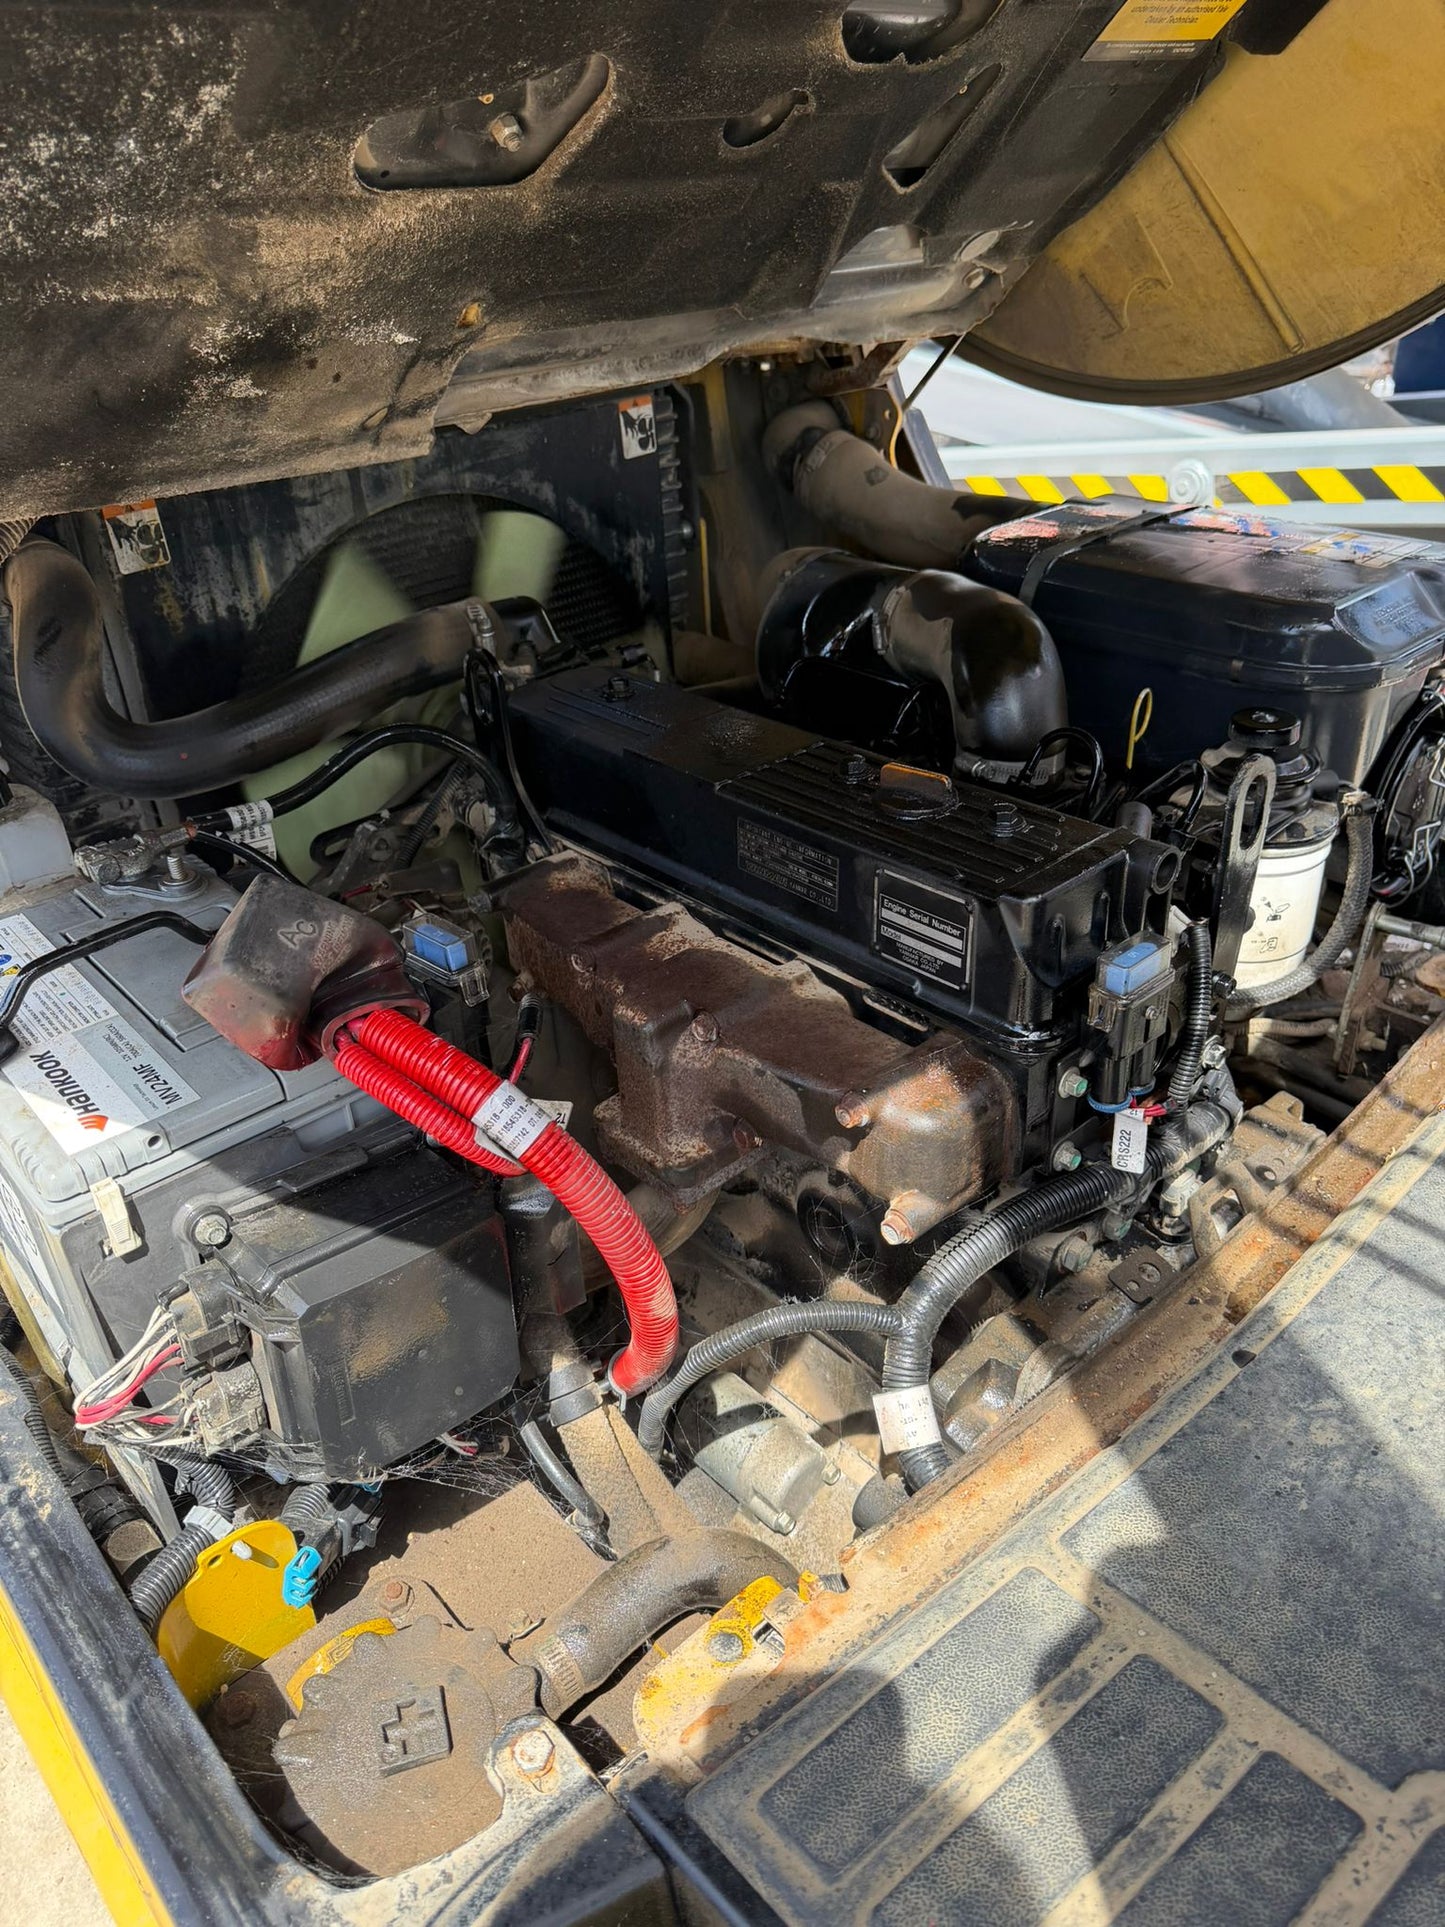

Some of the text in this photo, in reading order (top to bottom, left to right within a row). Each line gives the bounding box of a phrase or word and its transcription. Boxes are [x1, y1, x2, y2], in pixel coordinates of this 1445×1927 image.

[884, 899, 961, 937] Engine Serial Number
[132, 1063, 183, 1105] MV24MF
[1116, 1129, 1131, 1168] CRS222
